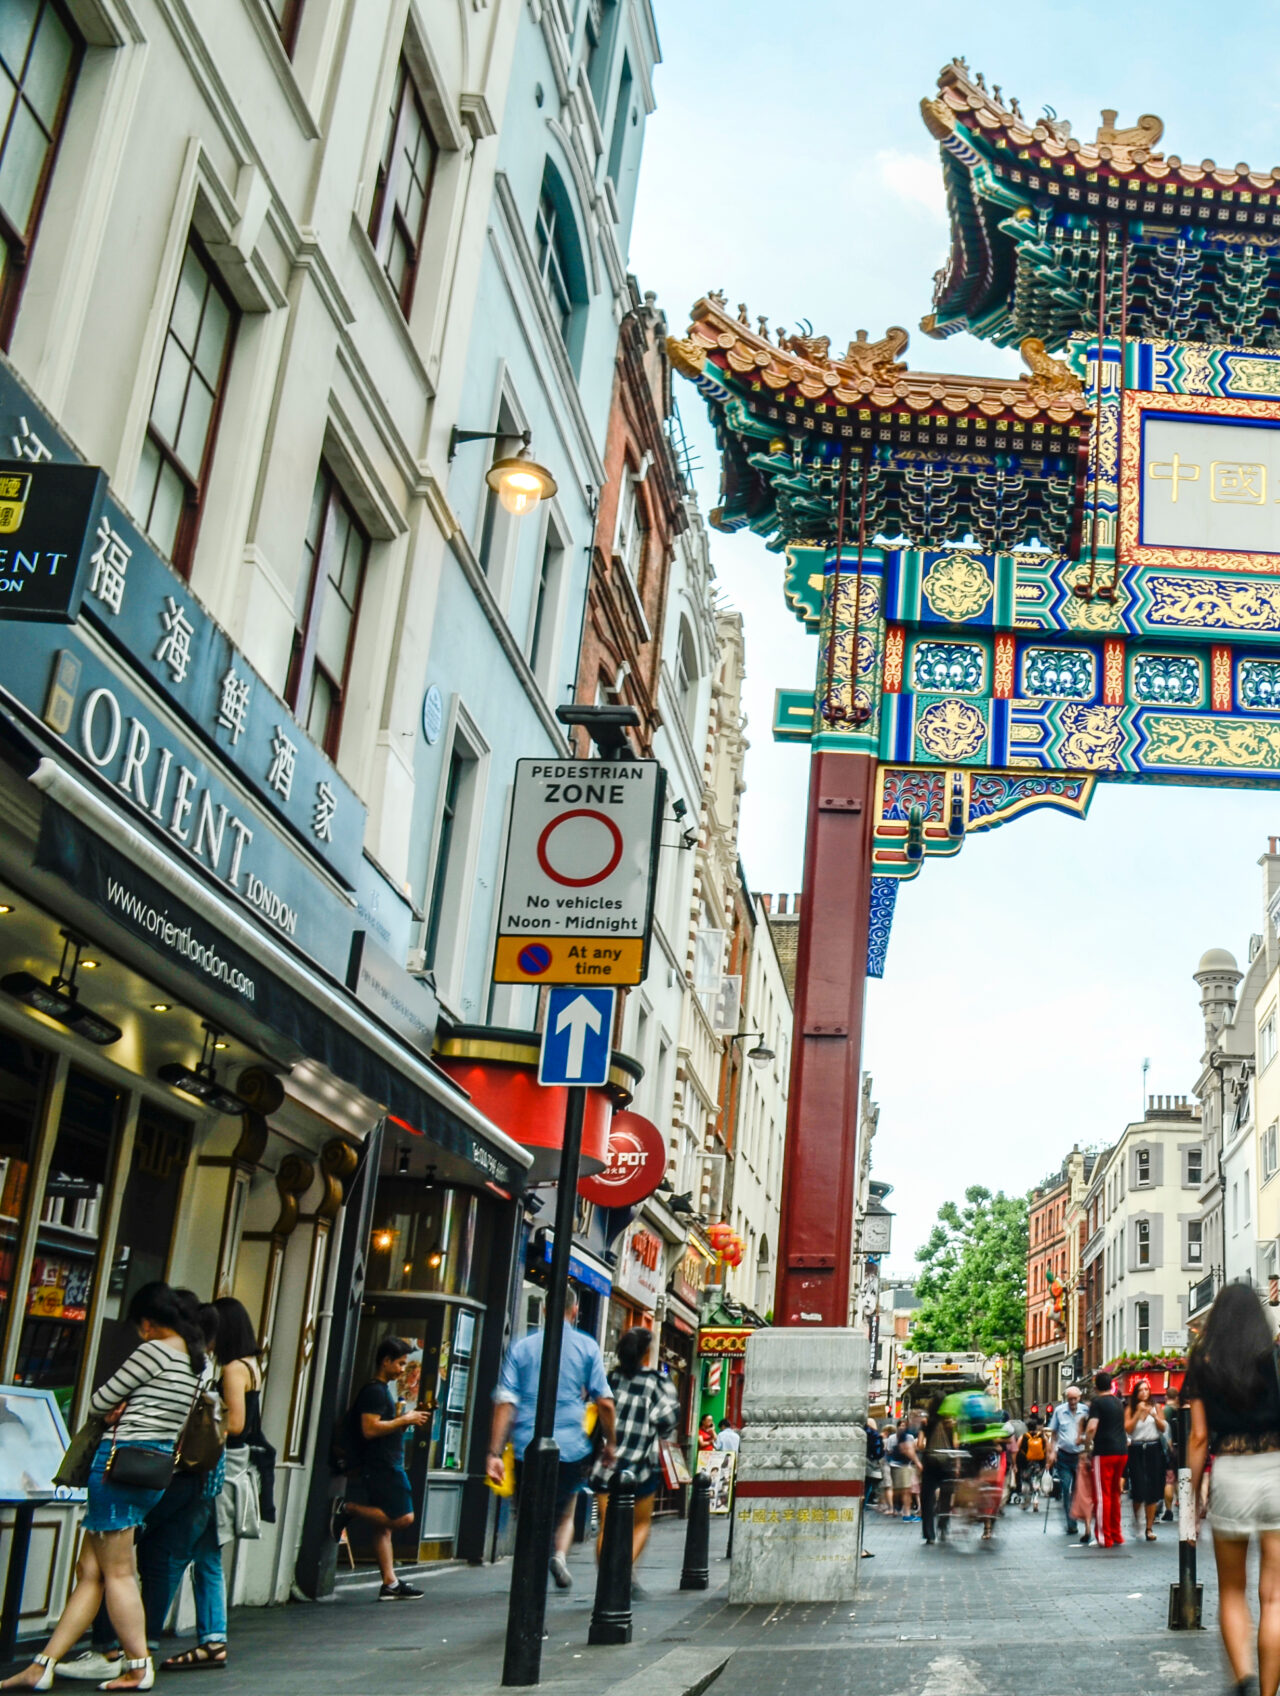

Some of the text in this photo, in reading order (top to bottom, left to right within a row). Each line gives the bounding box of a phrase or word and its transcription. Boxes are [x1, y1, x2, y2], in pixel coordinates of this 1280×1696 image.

[532, 766, 643, 780] PEDESTRIAN
[544, 784, 624, 804] ZONE
[82, 687, 298, 936] ORIENT LONDON
[527, 896, 622, 910] No vehicles
[507, 915, 551, 928] Noon
[565, 916, 638, 932] Midnight
[107, 876, 255, 1002] www.orientlondon.com
[568, 945, 622, 961] At any
[575, 962, 612, 975] time
[617, 1152, 649, 1166] POT
